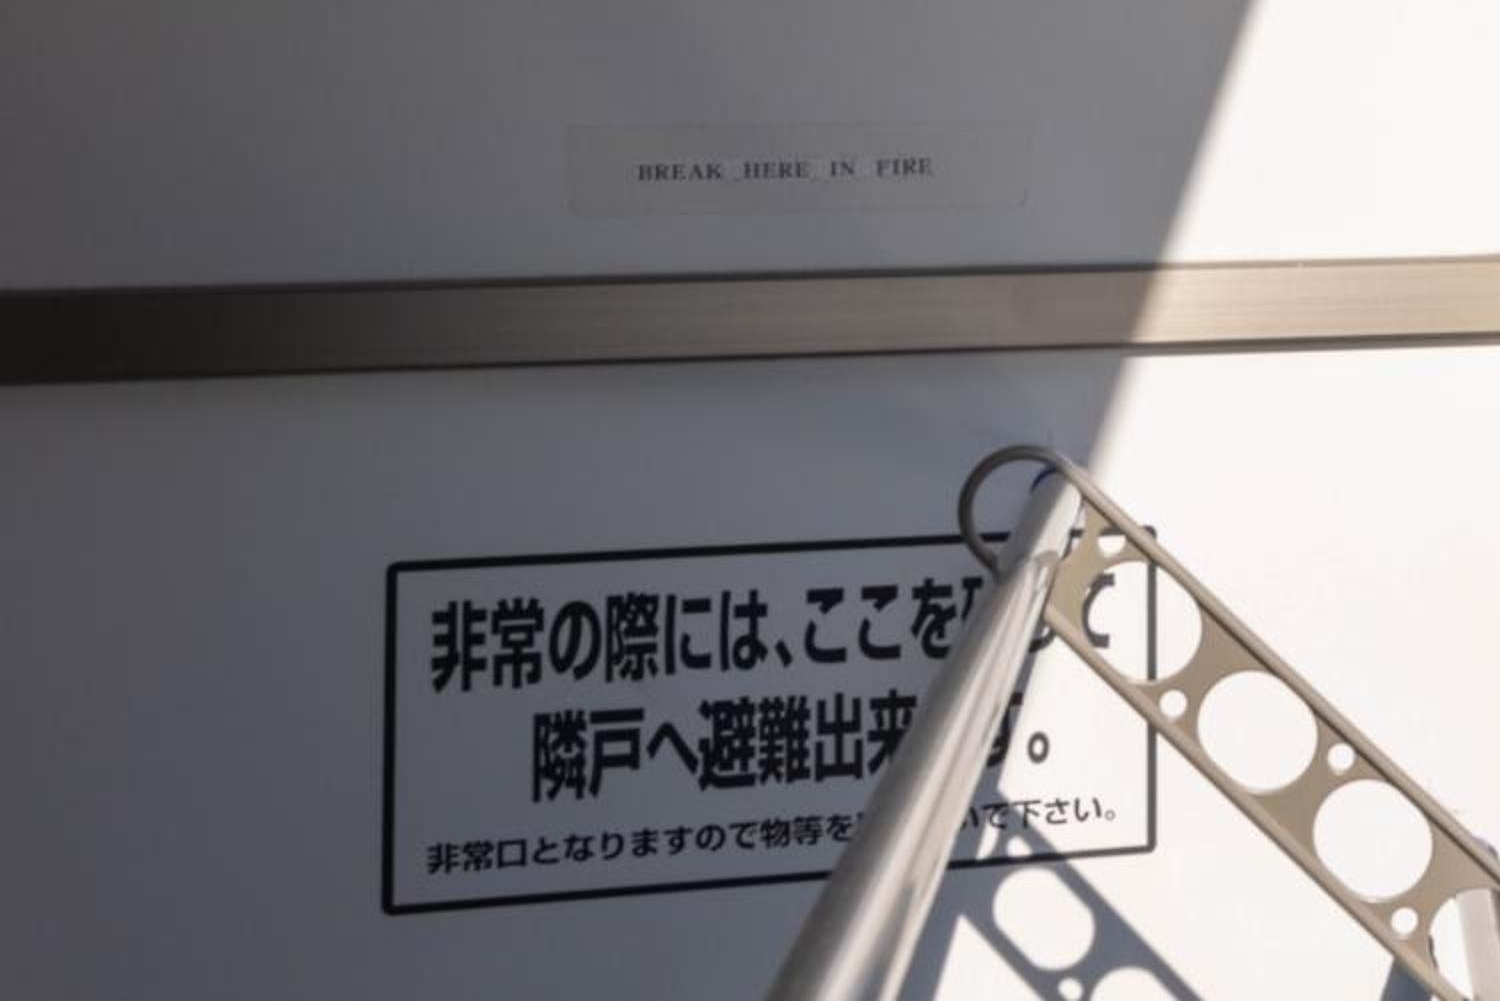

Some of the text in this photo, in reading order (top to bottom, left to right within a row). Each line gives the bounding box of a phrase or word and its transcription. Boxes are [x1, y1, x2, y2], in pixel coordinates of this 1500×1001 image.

[637, 158, 933, 181] BREAK HERE IN FIRE
[431, 572, 1115, 693] 非常の際には、ここをて
[532, 689, 1051, 803] 隣戸へ避難出来。
[427, 795, 1117, 874] 非常口となりますので物等をで下さい。
